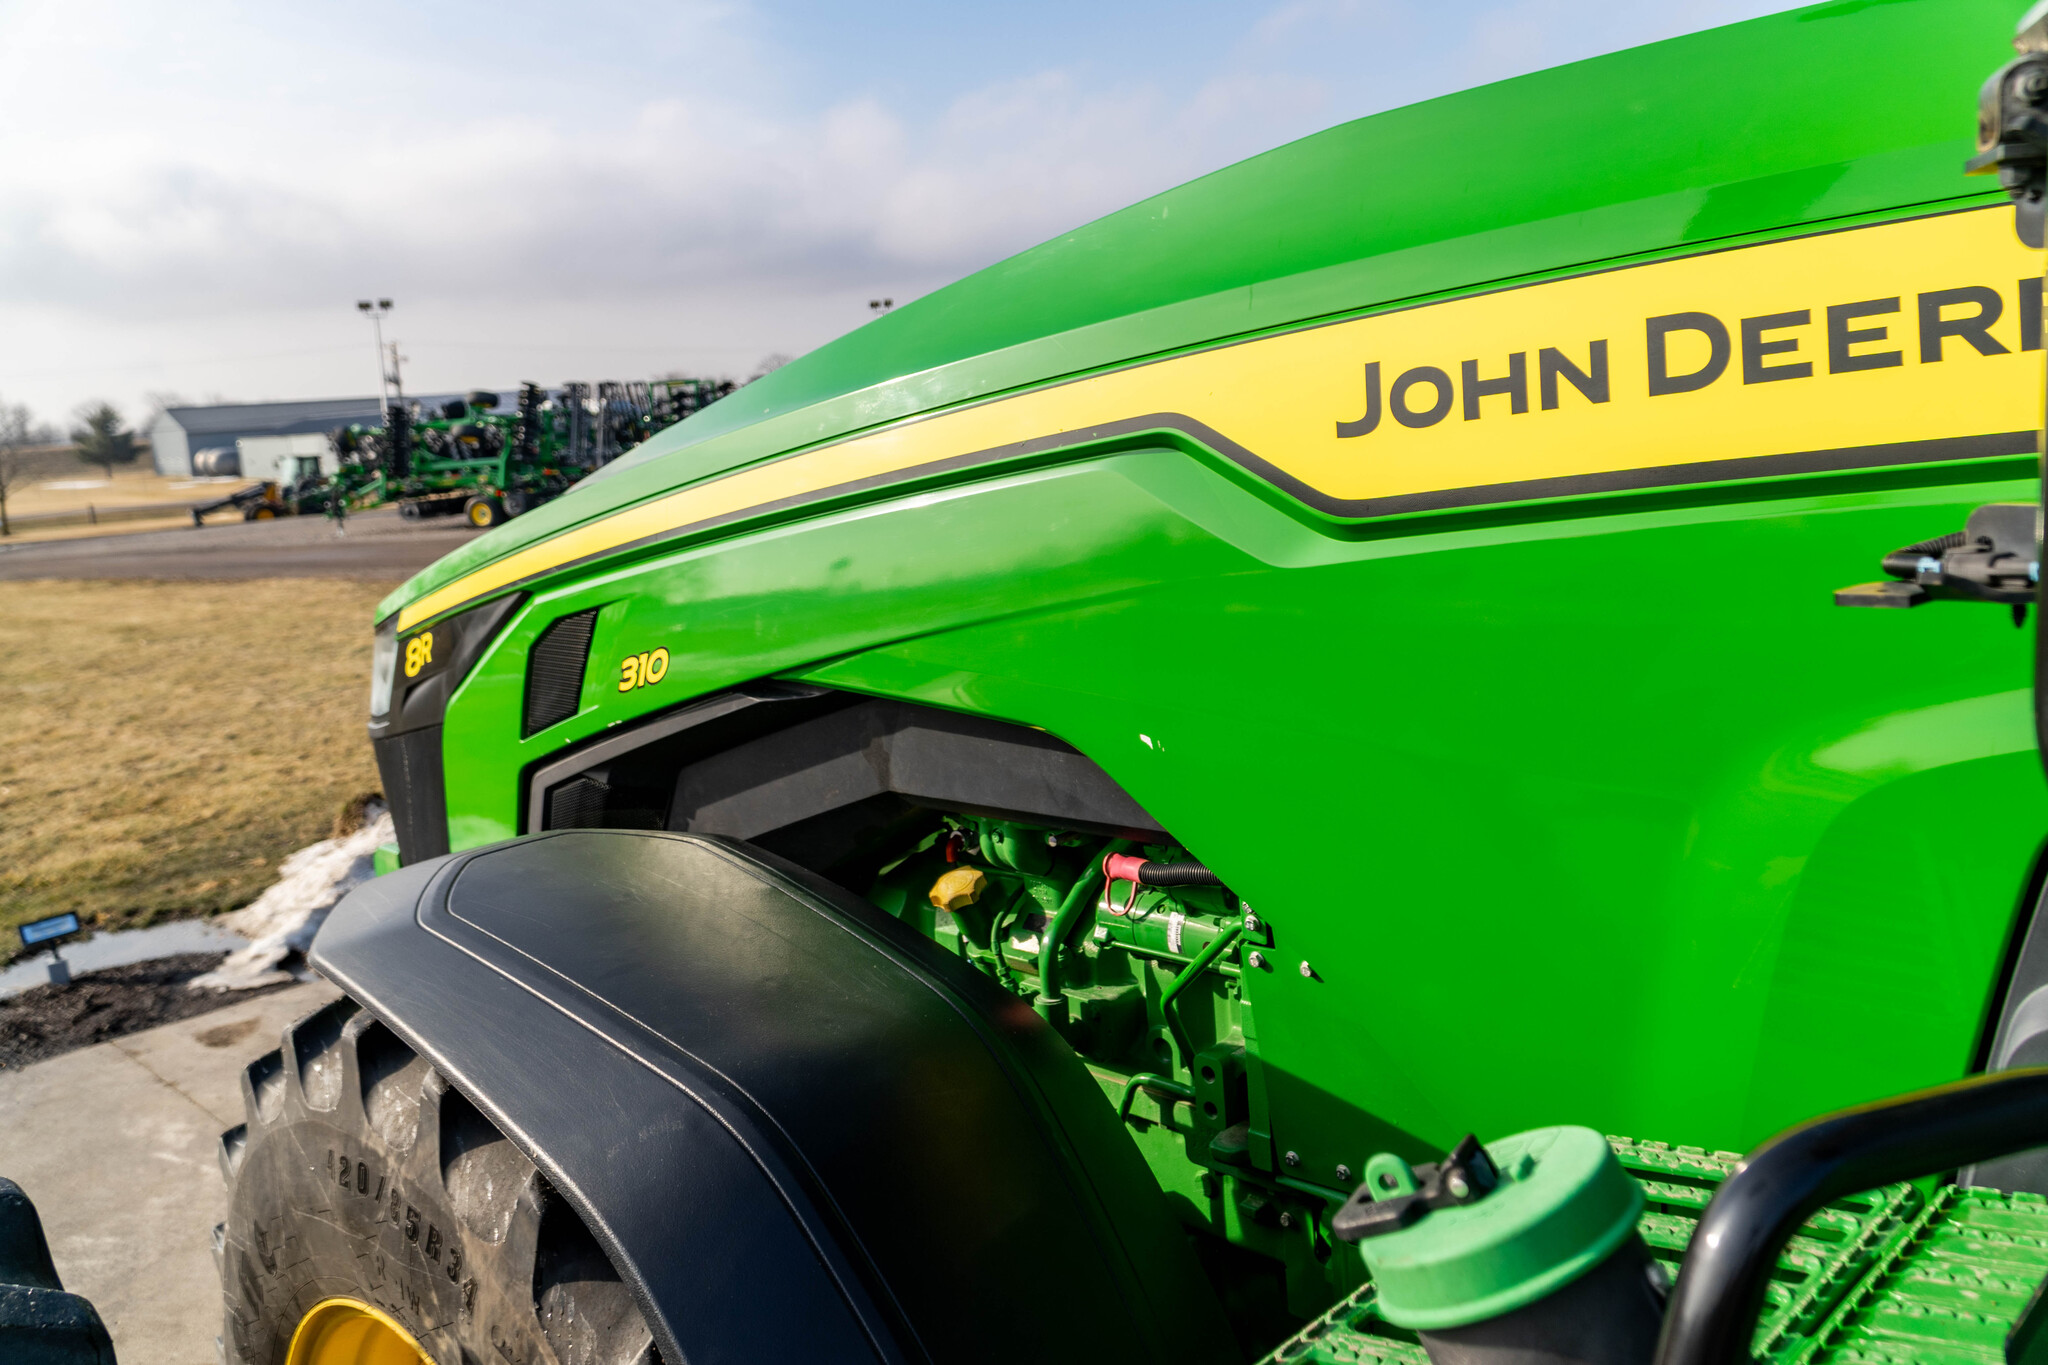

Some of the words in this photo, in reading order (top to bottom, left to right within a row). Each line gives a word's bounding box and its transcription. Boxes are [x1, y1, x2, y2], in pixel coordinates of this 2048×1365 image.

[1335, 338, 1611, 439] JOHN
[404, 631, 433, 678] 8R
[618, 646, 670, 693] 310
